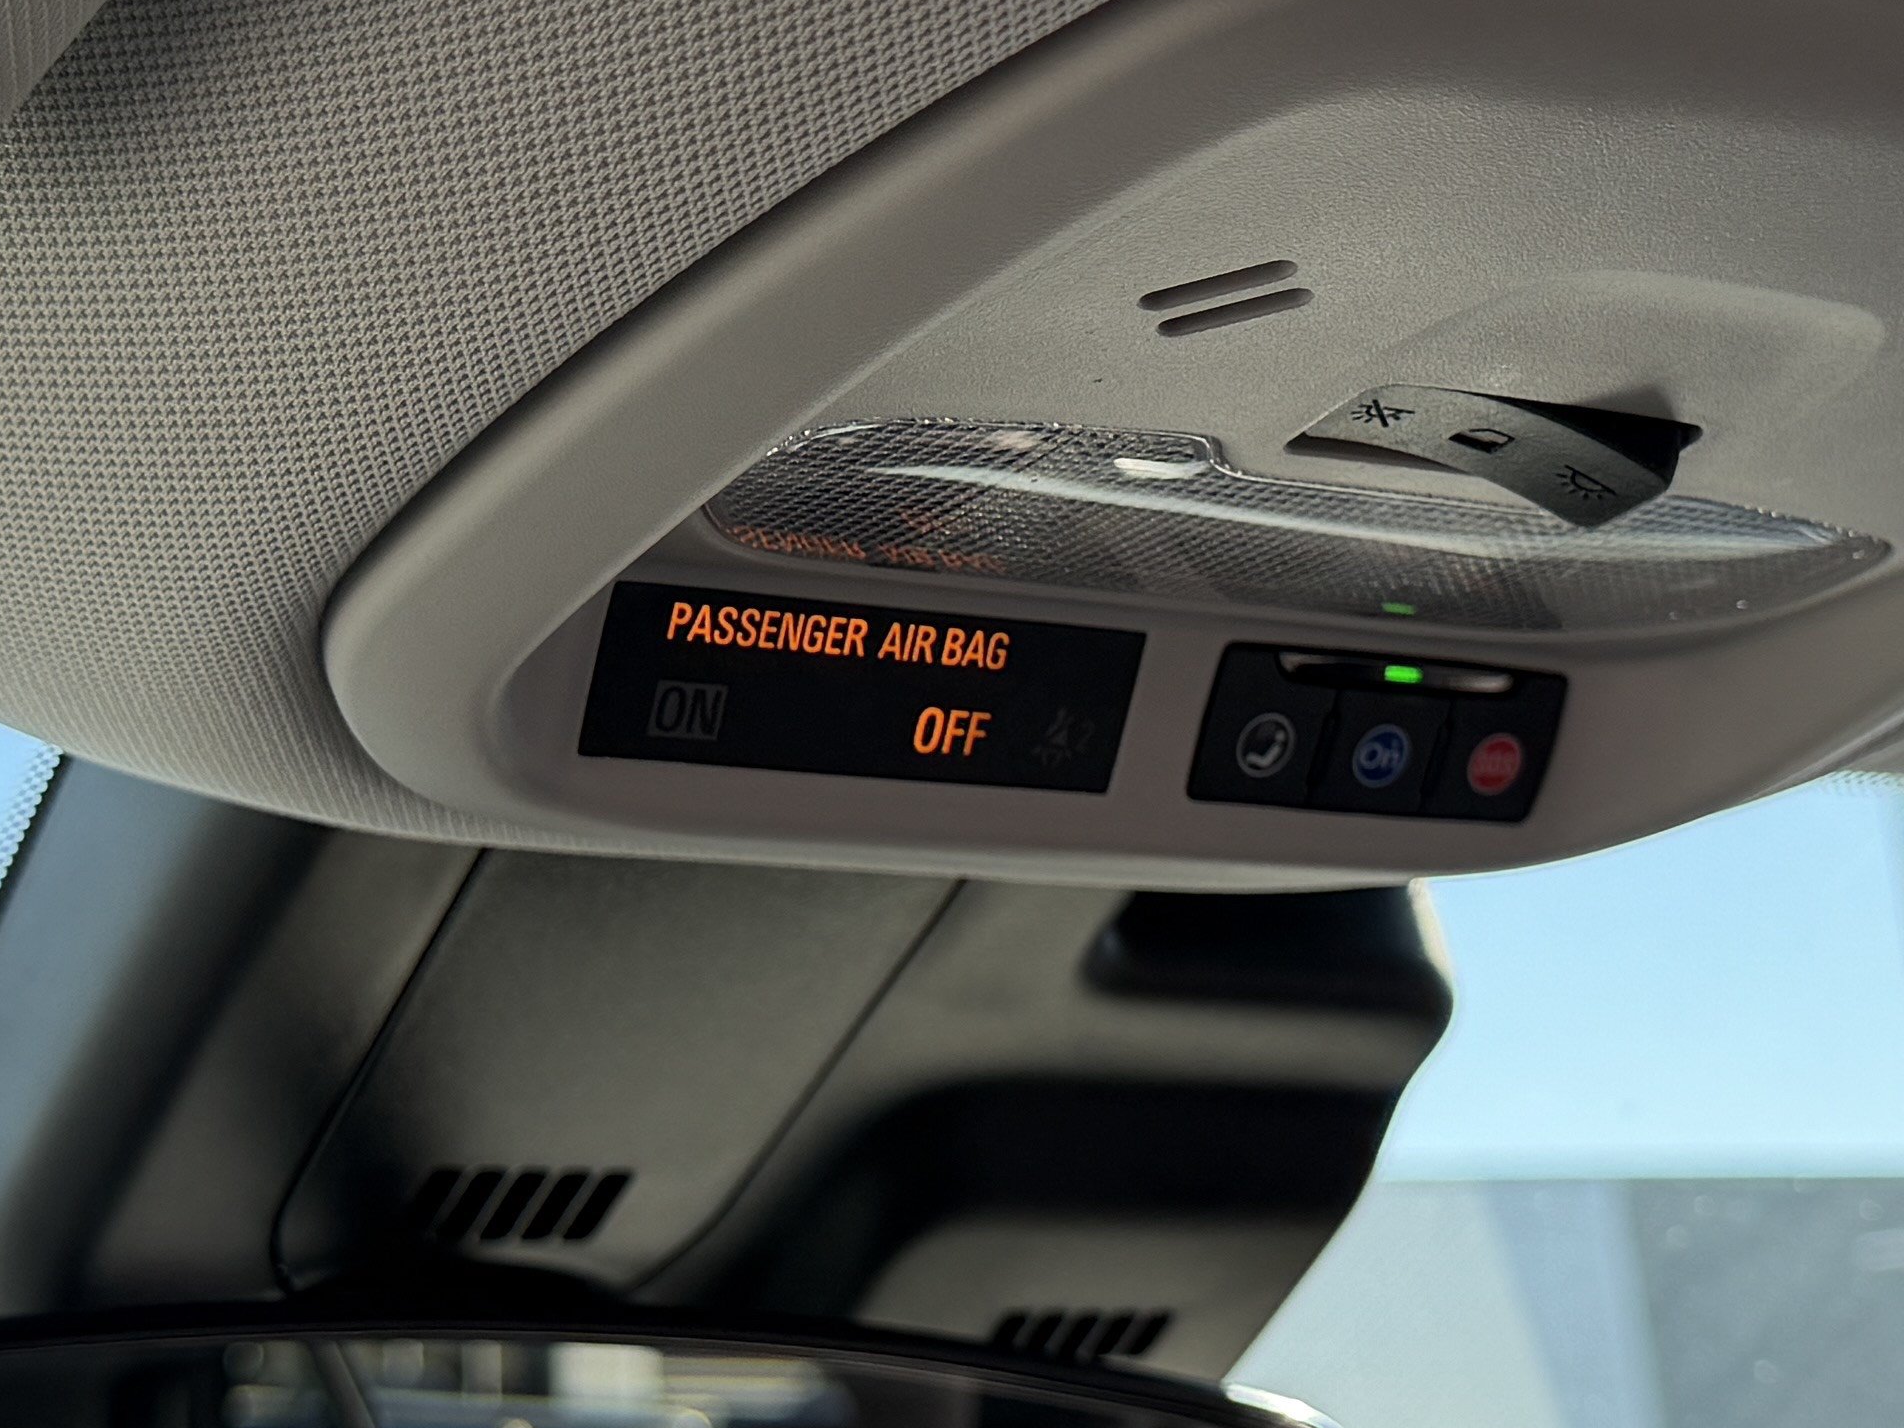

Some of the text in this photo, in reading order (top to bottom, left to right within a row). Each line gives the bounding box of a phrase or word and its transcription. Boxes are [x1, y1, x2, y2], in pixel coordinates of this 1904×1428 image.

[666, 601, 1010, 670] PASSENGER AIR BAG
[653, 684, 724, 737] ON
[912, 706, 993, 757] OFF
